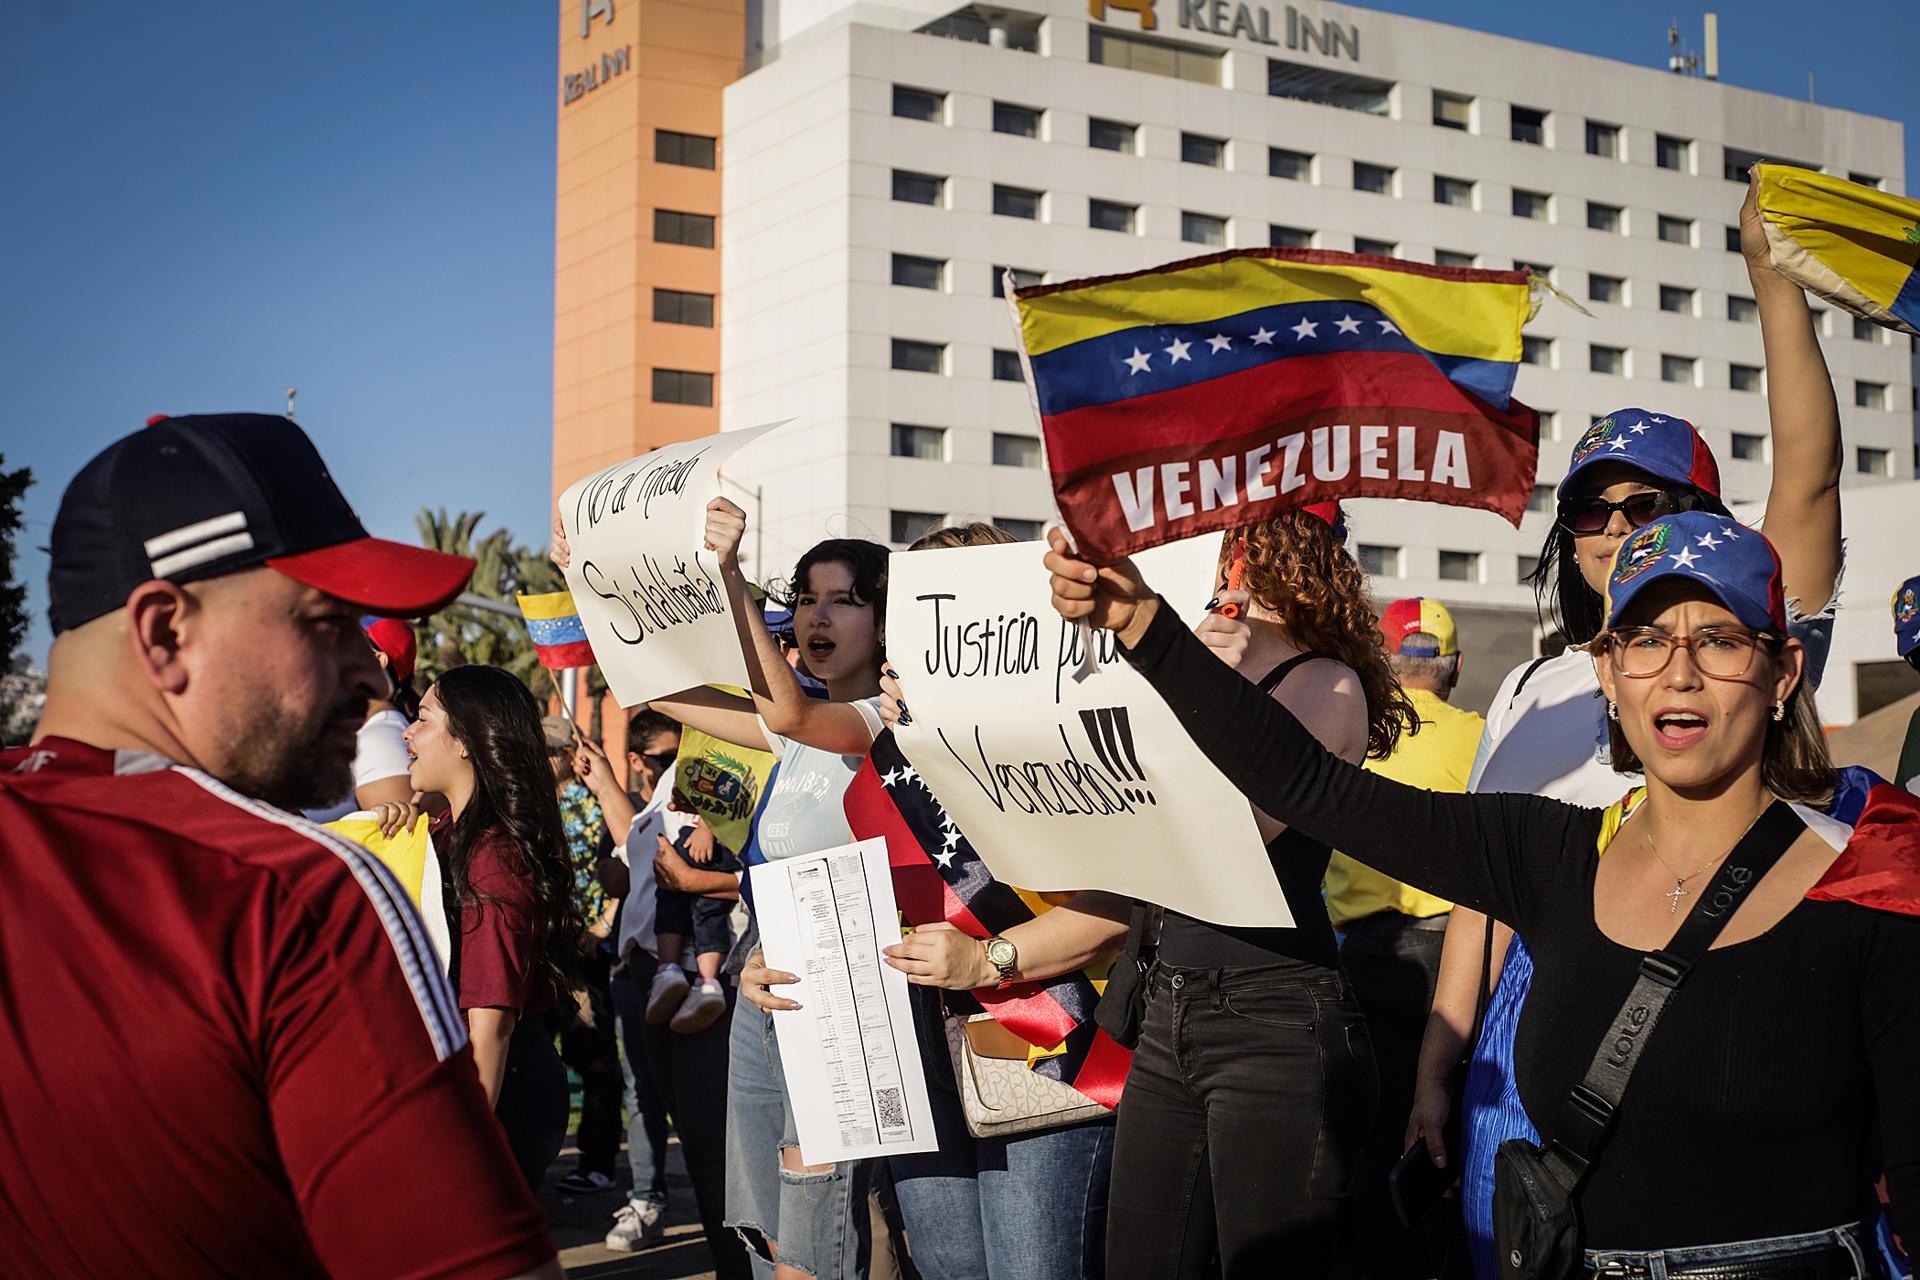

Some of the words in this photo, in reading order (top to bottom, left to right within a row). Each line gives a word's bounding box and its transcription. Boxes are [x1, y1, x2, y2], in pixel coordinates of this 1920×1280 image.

[1178, 0, 1278, 46] REAL
[1285, 4, 1360, 62] INN
[576, 459, 638, 535] No
[1111, 424, 1472, 534] VENEZUELA
[916, 593, 1040, 678] Justicia
